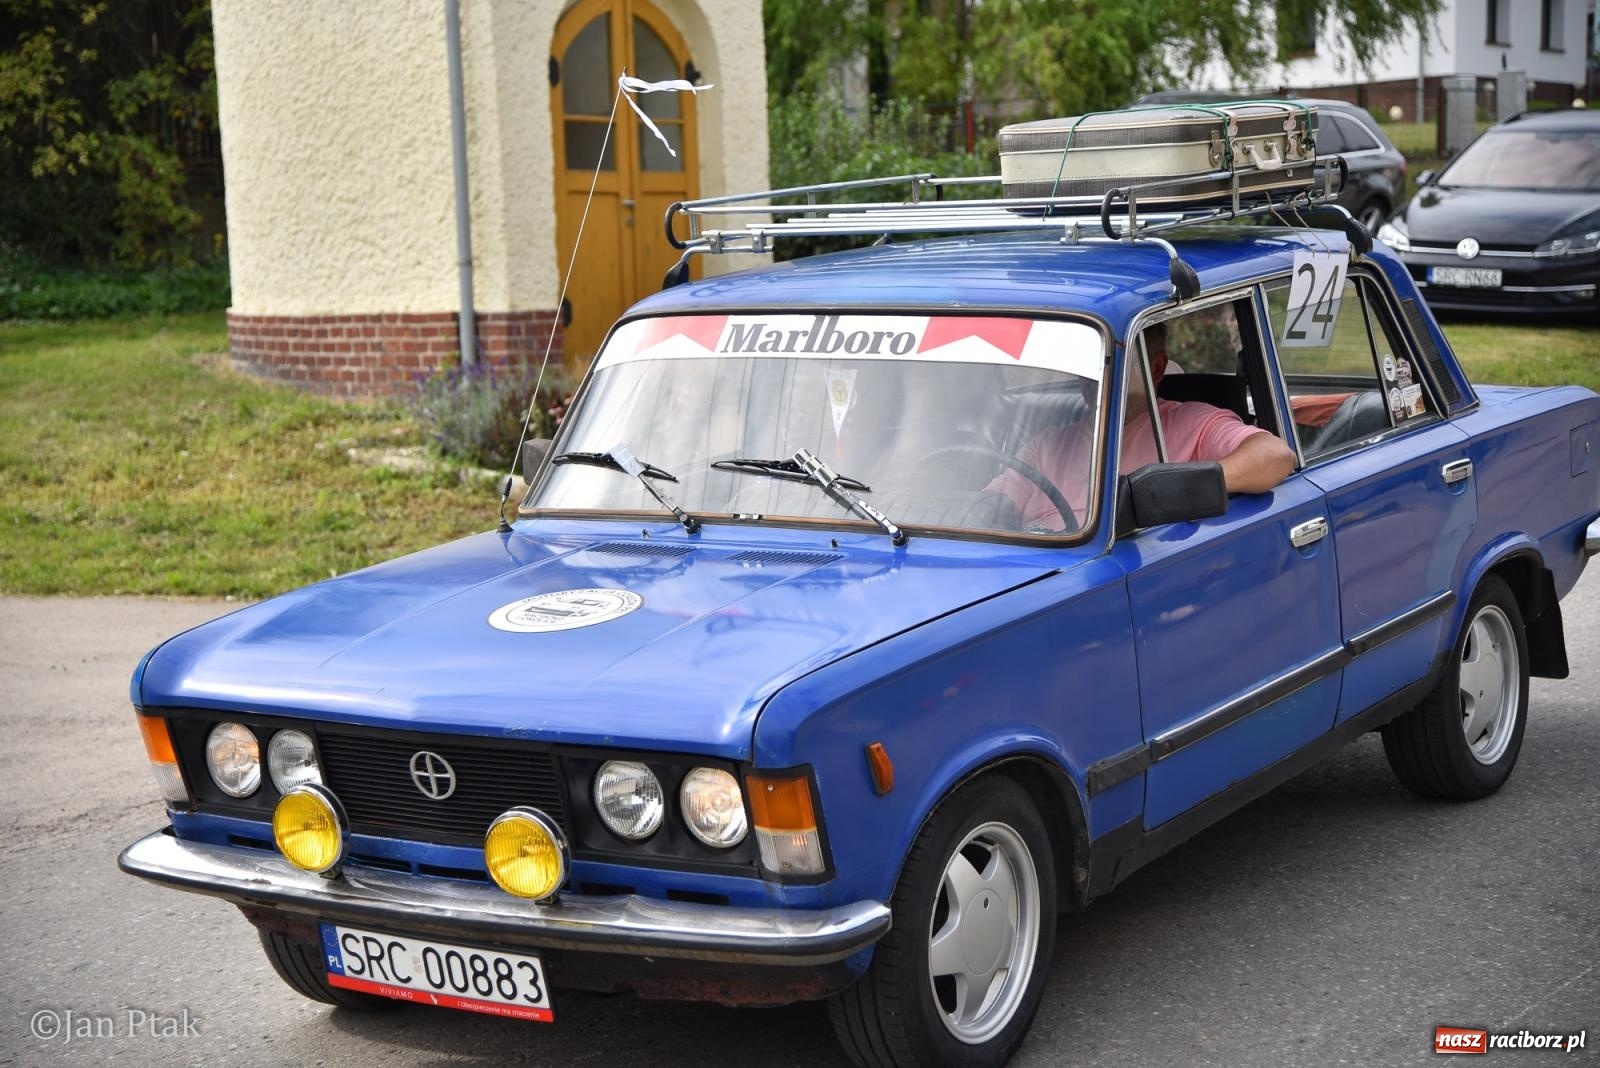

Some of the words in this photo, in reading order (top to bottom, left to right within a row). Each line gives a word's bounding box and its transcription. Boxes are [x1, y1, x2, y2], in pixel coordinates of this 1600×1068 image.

[1286, 262, 1339, 340] 24
[720, 314, 916, 356] Marlboro
[328, 955, 342, 969] PL
[341, 932, 413, 984] SRC
[421, 945, 543, 1004] 00883
[380, 986, 413, 1000] VIVIAMO
